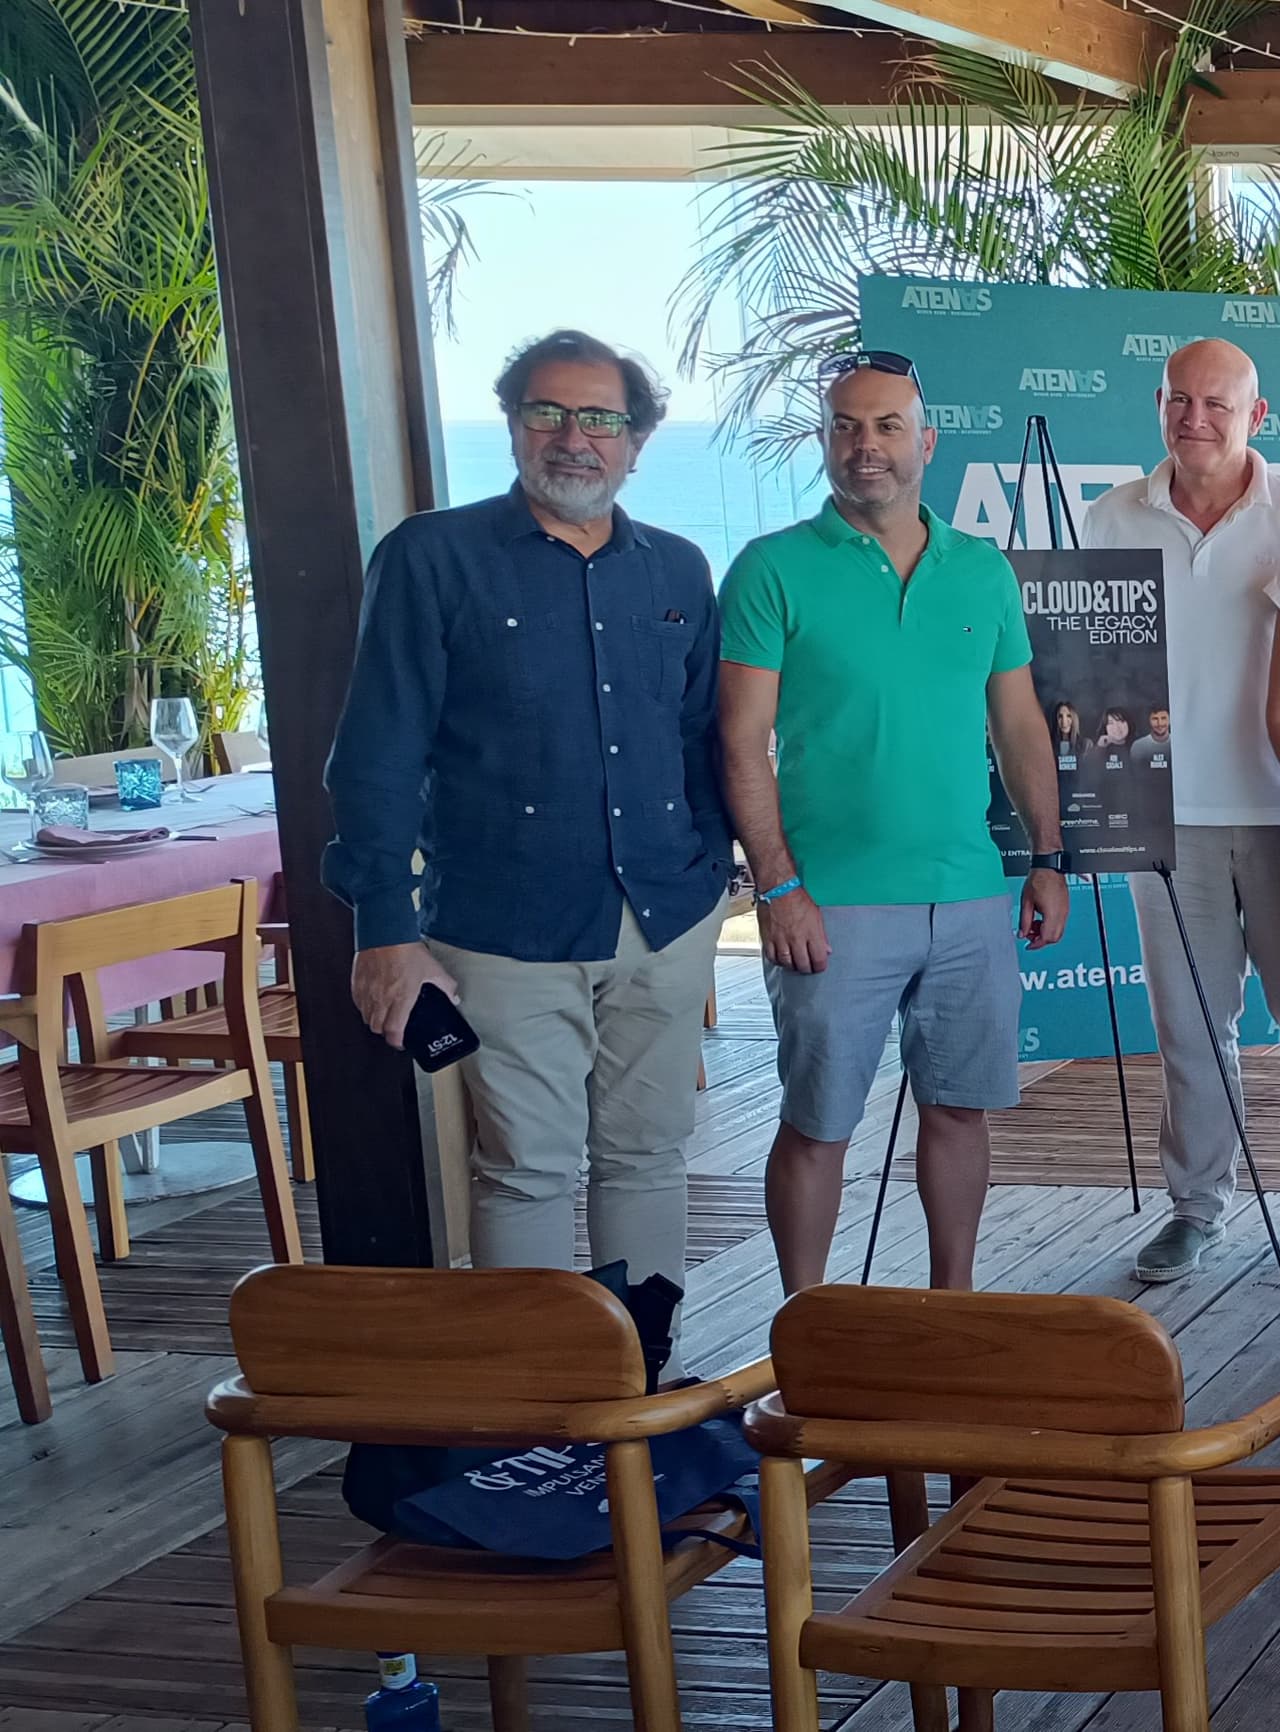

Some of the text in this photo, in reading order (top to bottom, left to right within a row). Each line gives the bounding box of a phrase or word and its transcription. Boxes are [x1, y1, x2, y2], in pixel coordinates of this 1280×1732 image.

[902, 286, 992, 312] ATENAS
[1122, 334, 1206, 356] ATEN
[1019, 368, 1107, 393] ATENAS
[926, 404, 1003, 431] TENAS
[1022, 580, 1157, 615] CLOUD&TIPS
[1046, 616, 1157, 631] THE LEGACY
[1090, 630, 1157, 645] EDITION
[1020, 960, 1147, 991] w.atena
[522, 1454, 607, 1498] IMPULSAN
